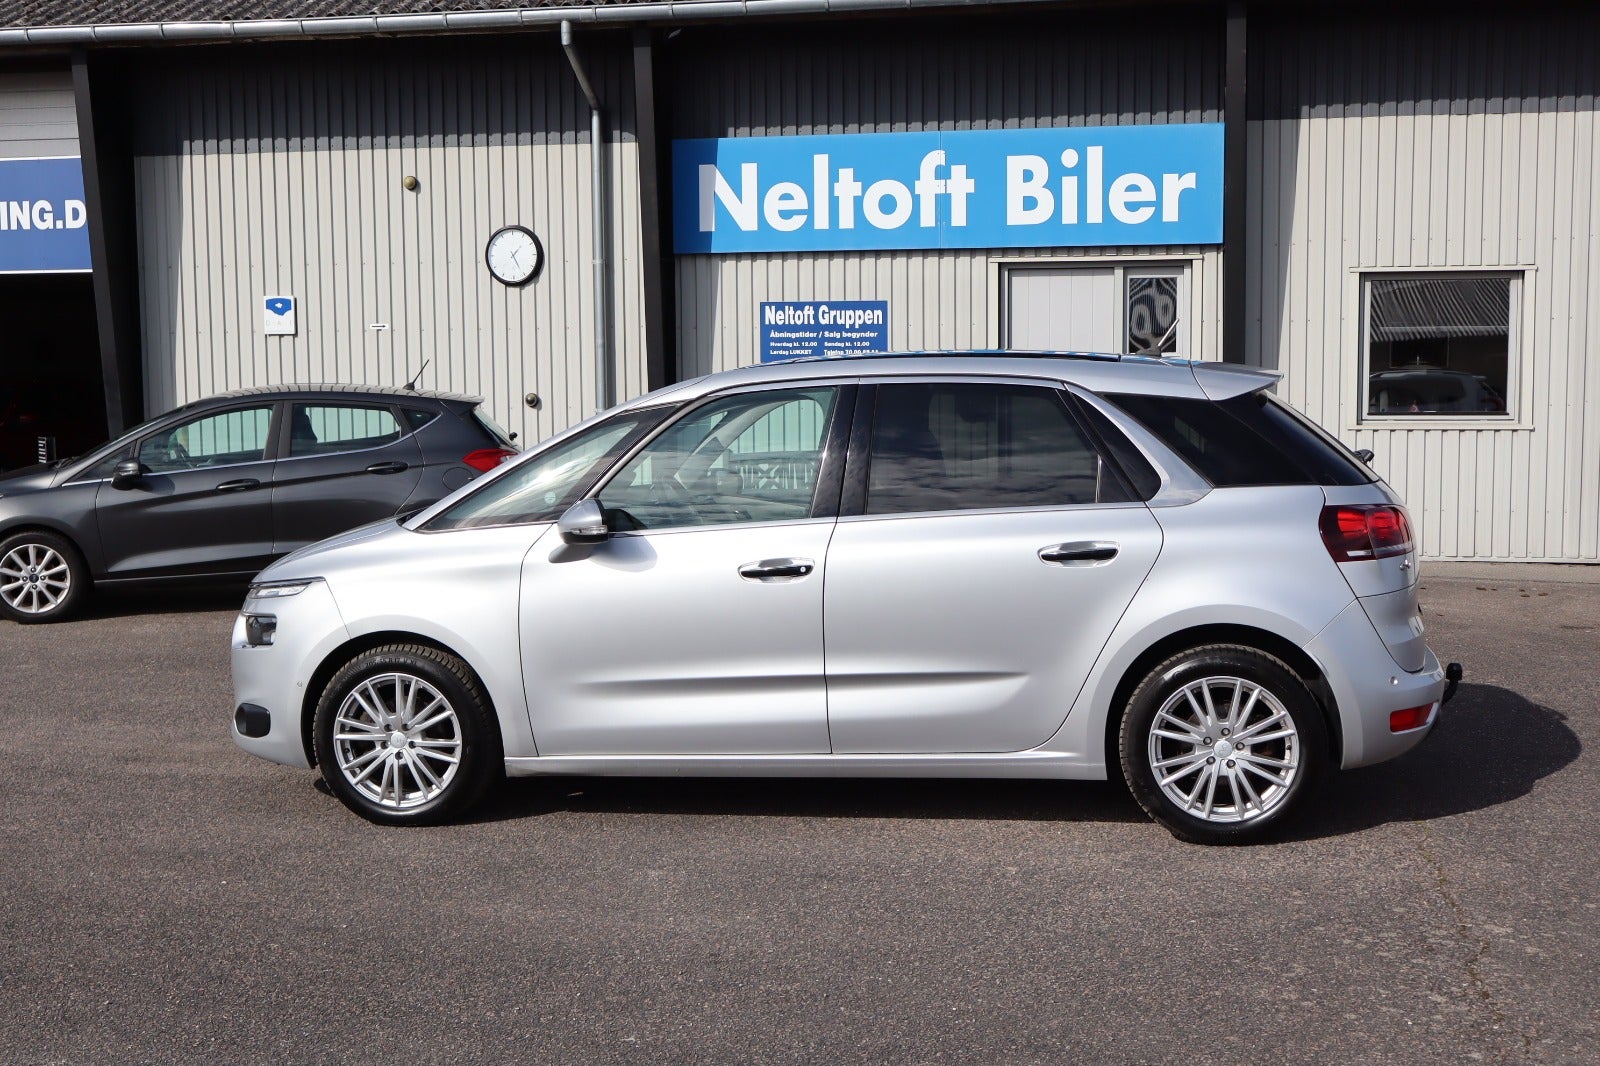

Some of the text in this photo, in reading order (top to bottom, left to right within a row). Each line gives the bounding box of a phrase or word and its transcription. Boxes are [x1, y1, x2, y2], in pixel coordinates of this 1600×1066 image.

[699, 145, 1196, 232] Neltoft Biler
[764, 304, 883, 328] Neltoft Gruppen
[769, 329, 818, 339] Åbningstider
[824, 330, 841, 339] Salg
[842, 330, 879, 339] begynder
